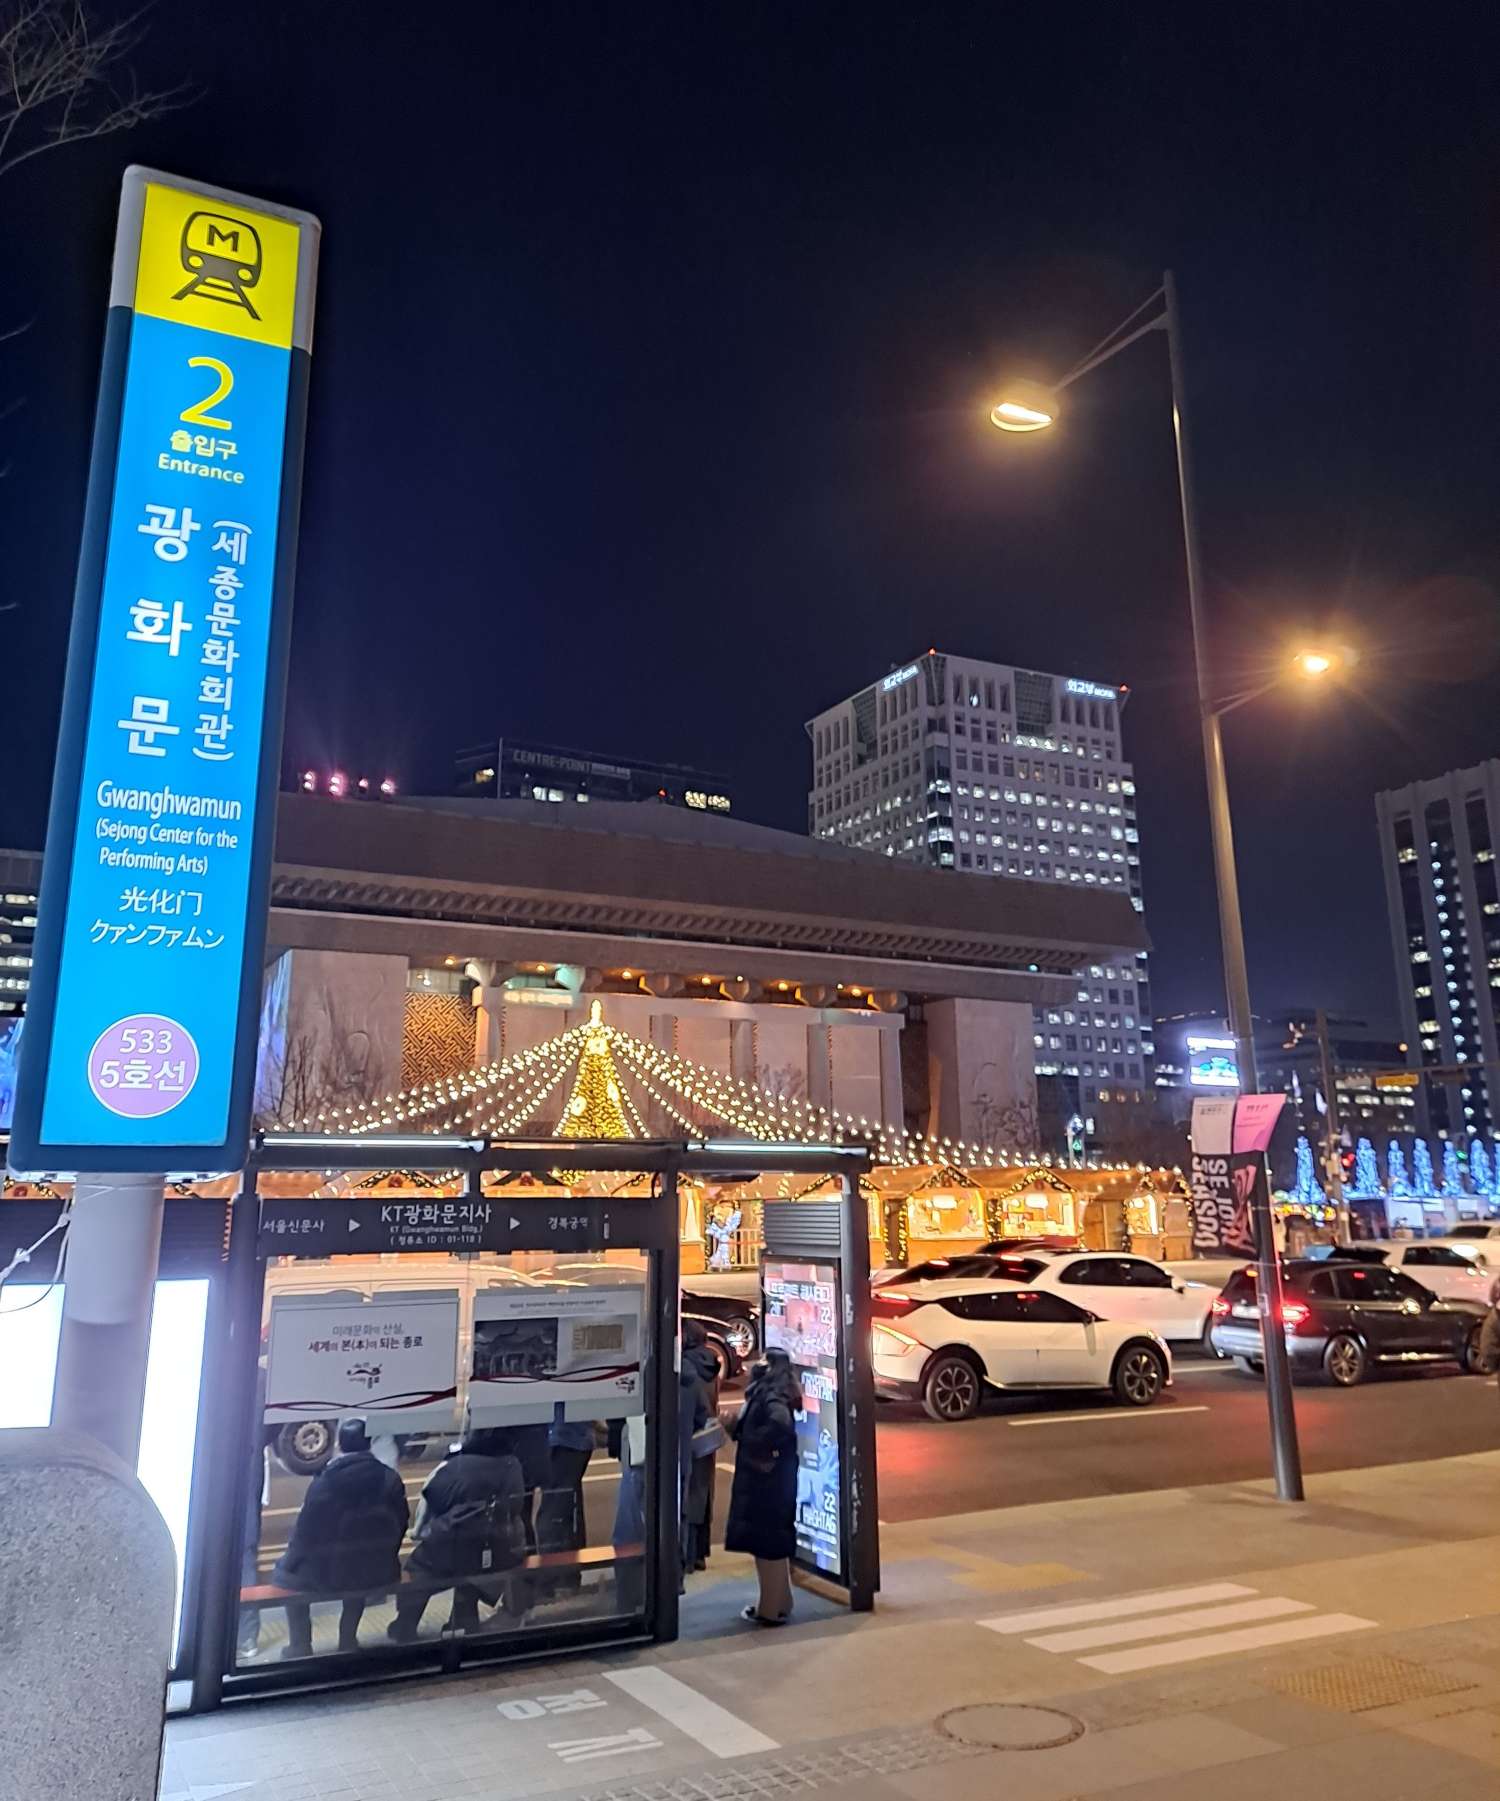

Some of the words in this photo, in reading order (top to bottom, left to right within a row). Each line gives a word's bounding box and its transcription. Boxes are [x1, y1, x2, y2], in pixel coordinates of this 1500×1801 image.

[207, 223, 240, 252] M
[179, 356, 234, 431] 2
[169, 429, 239, 461] 출입구
[158, 453, 245, 485] Entrance
[117, 503, 202, 758] 광화문
[192, 519, 253, 761] (세종문화회관)
[96, 780, 242, 821] Gwanghwamun
[96, 817, 148, 846] (Sejong
[150, 822, 194, 843] Center
[195, 827, 214, 846] for
[216, 829, 238, 849] the
[99, 847, 175, 876] Performing
[176, 854, 208, 876] Arts)
[119, 886, 203, 916] 光化门
[89, 919, 225, 949] クァンファムン
[119, 1027, 173, 1055] 533
[98, 1058, 187, 1092] 5호선
[262, 1219, 325, 1233] 서울신문사
[381, 1204, 492, 1225] KT광화문지사
